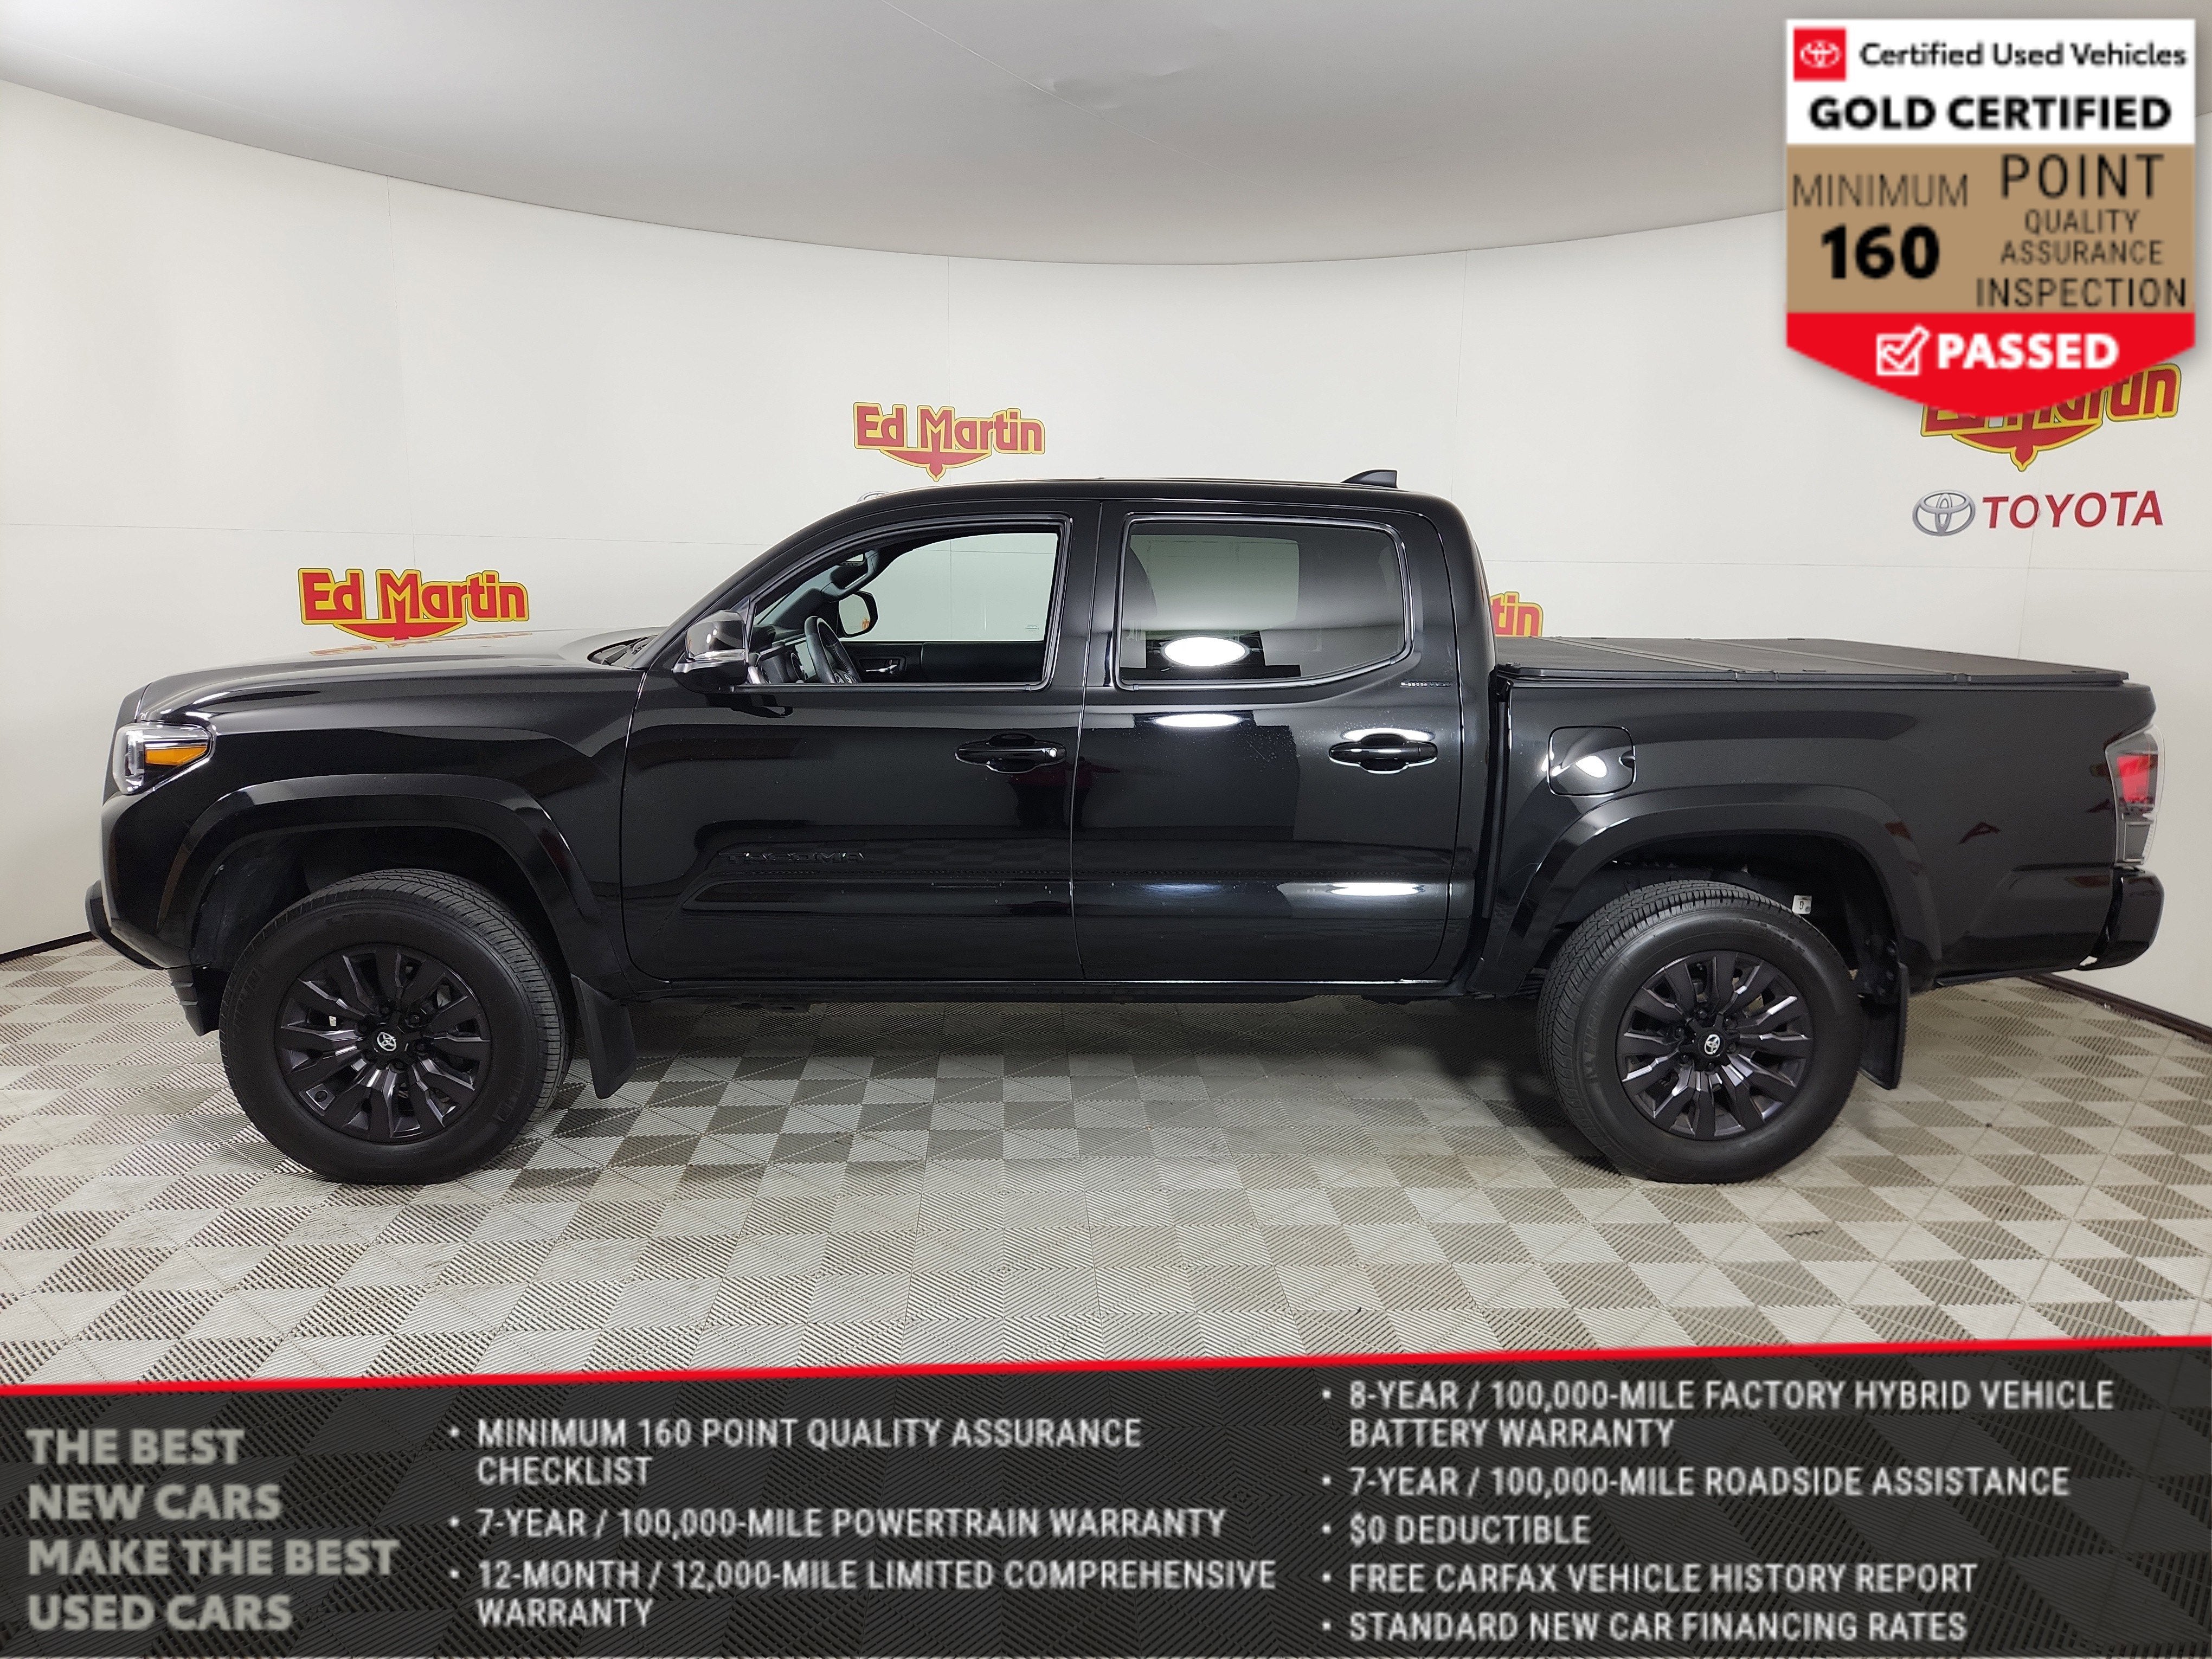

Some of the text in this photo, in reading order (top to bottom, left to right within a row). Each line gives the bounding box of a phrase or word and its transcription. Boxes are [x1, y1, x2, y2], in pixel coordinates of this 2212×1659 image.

[854, 402, 1045, 454] Ed Martin
[1982, 490, 2164, 529] TOYOTA
[298, 568, 529, 625] Ed Martin
